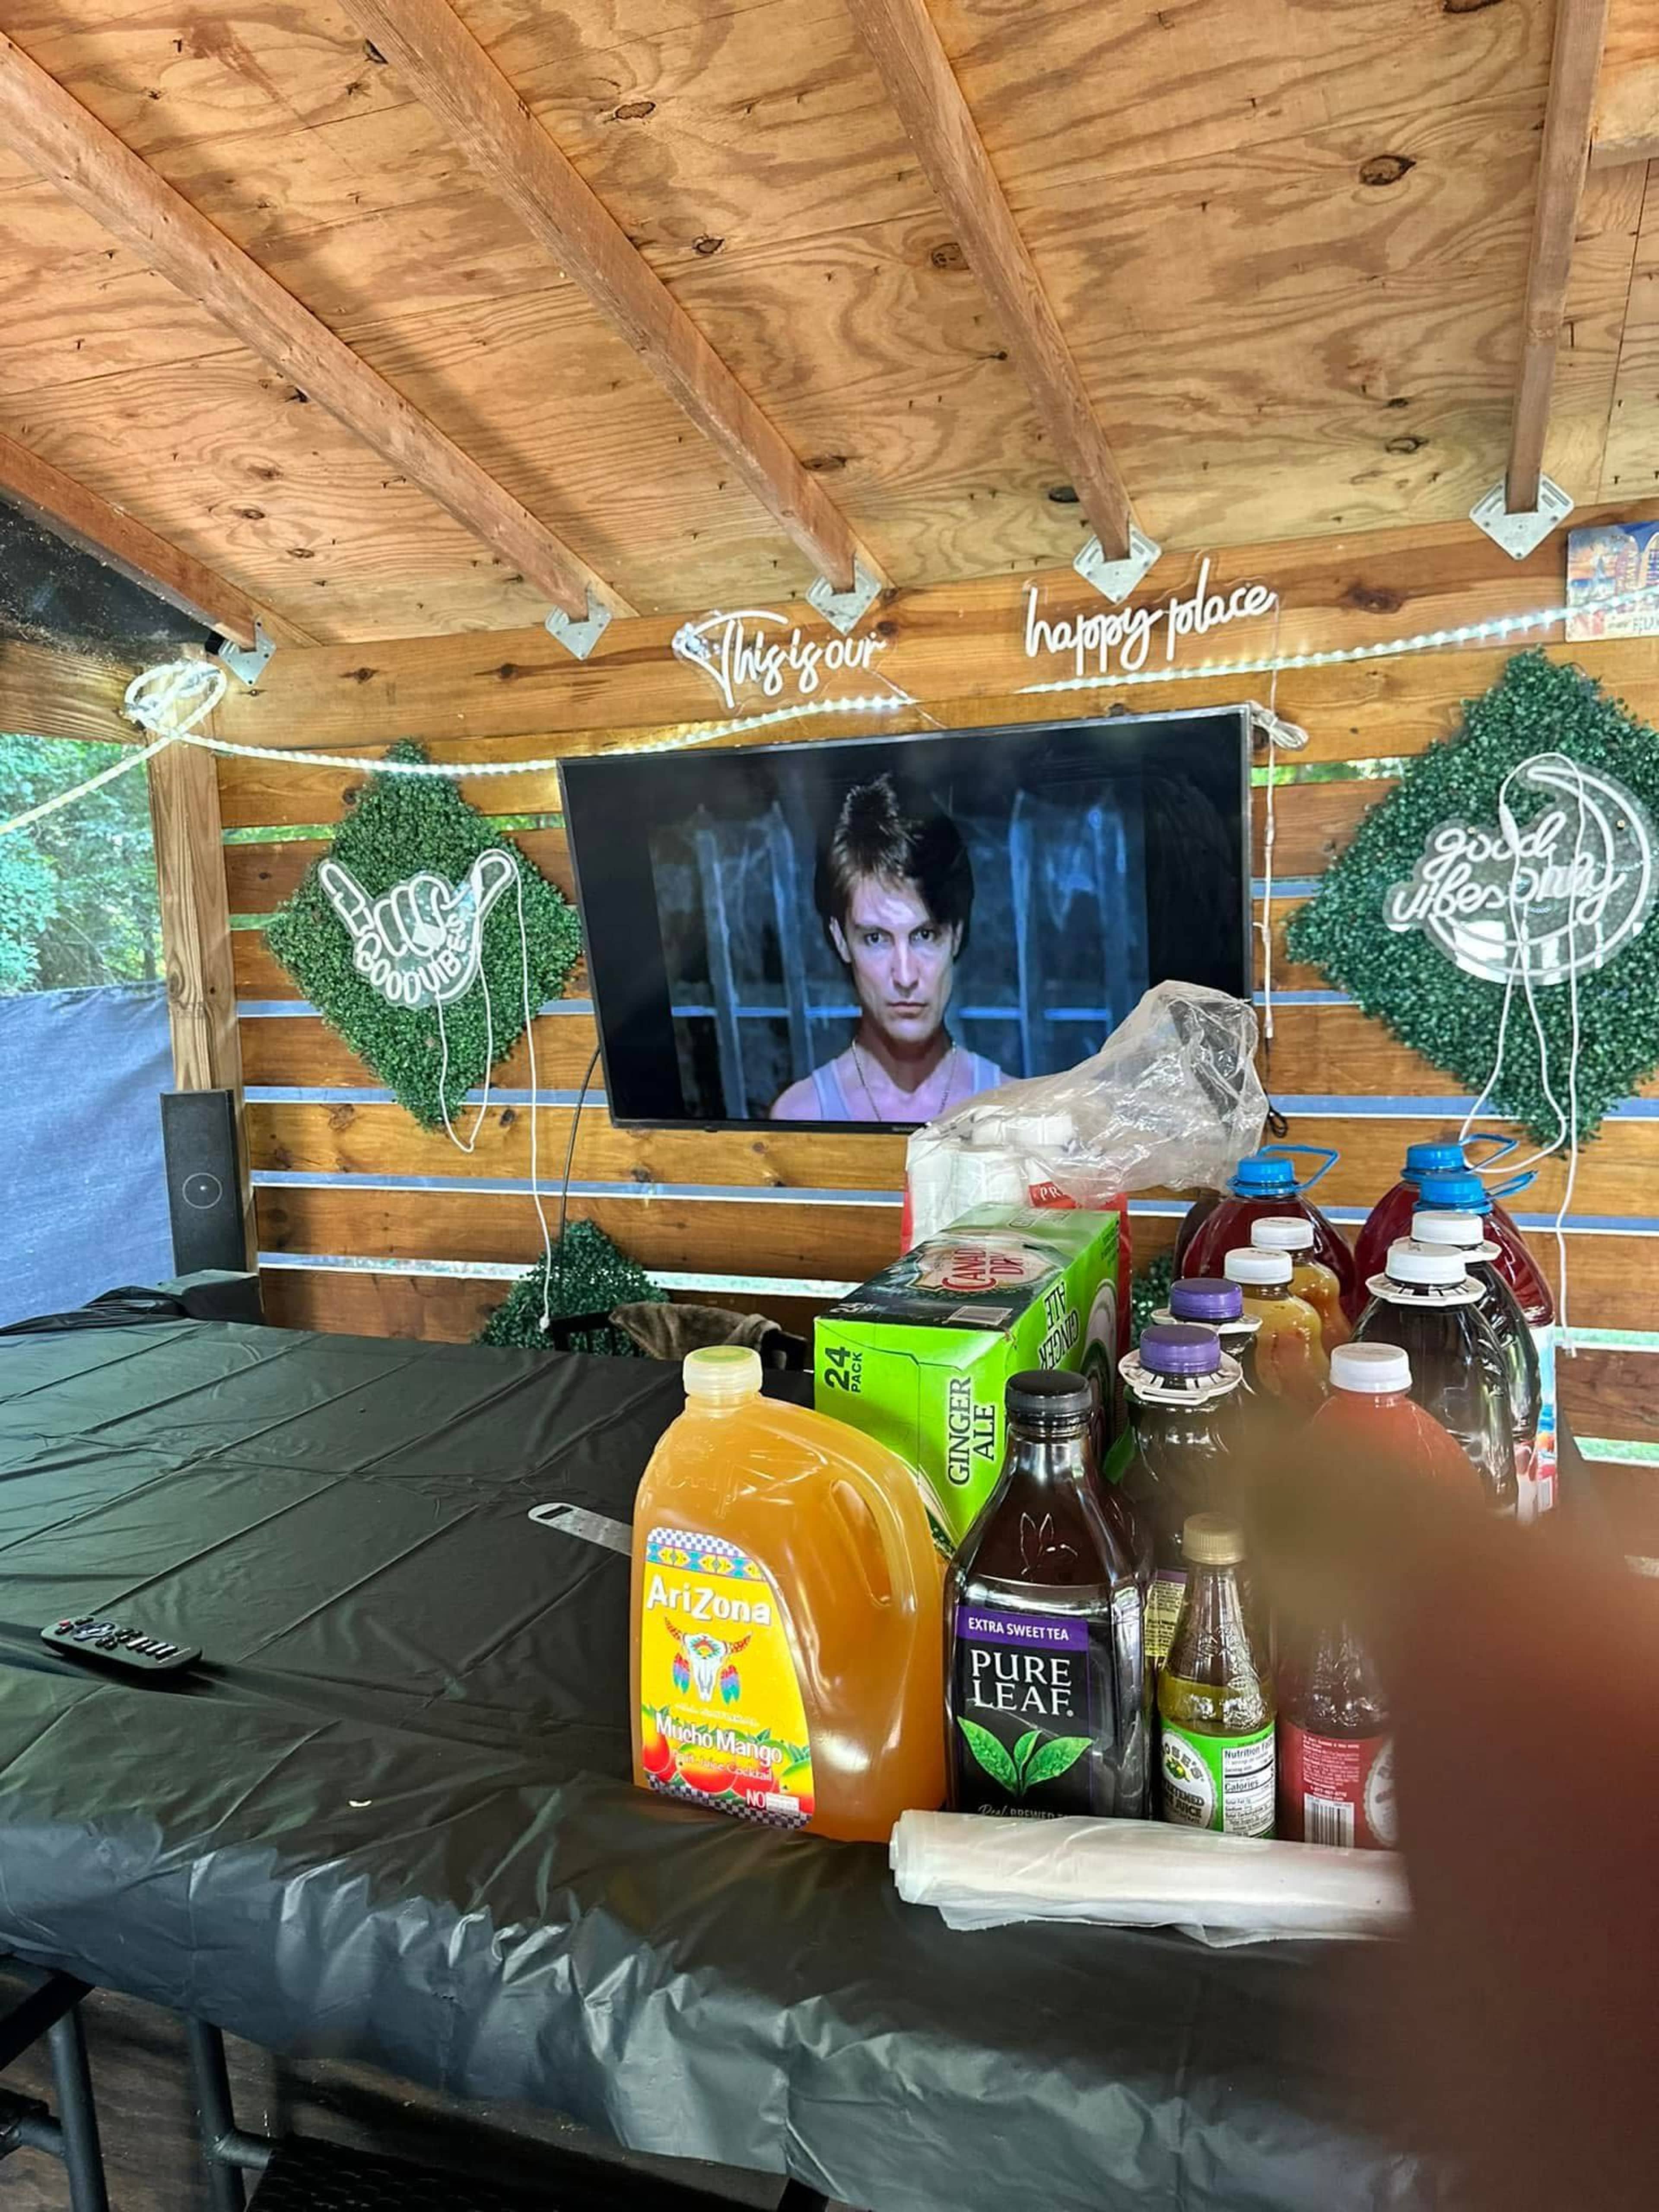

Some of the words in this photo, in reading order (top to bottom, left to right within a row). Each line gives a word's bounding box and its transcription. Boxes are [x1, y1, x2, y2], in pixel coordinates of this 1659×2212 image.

[1025, 587, 1163, 676] happy
[1166, 558, 1278, 661] place
[673, 609, 789, 709] This
[790, 628, 824, 694] is
[825, 632, 888, 669] our
[1422, 811, 1567, 881] good
[1392, 863, 1507, 920] vibes
[1044, 1281, 1066, 1331] ALE
[1039, 1309, 1079, 1370] GINGER
[823, 1346, 851, 1392] 24
[850, 1351, 864, 1393] PACK
[947, 1377, 971, 1486] GINGER
[973, 1405, 995, 1462] ALE
[646, 1574, 772, 1626] AriZona
[968, 1617, 1004, 1635] EXTRA
[1007, 1623, 1046, 1639] SWEET
[1047, 1627, 1069, 1641] TEA
[970, 1649, 1072, 1687] PURE
[655, 1712, 712, 1748] Mucho
[716, 1728, 782, 1767] Mango
[1224, 1746, 1260, 1759] Nutrition
[746, 1789, 766, 1808] NO
[1224, 1779, 1259, 1791] Calories
